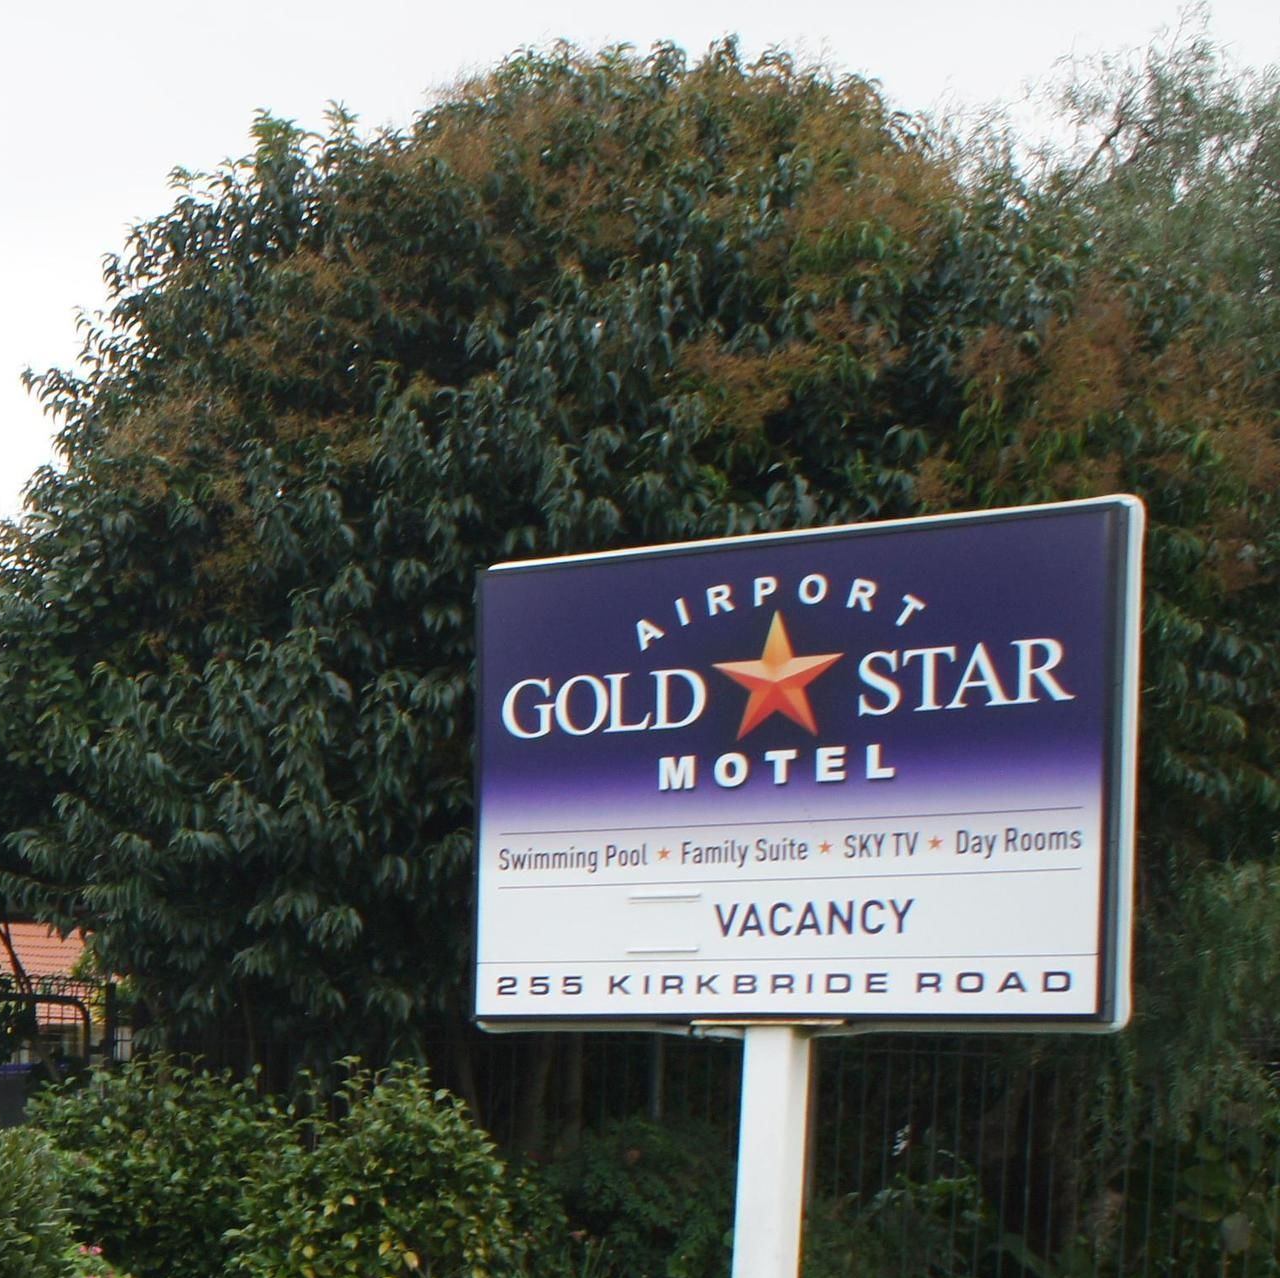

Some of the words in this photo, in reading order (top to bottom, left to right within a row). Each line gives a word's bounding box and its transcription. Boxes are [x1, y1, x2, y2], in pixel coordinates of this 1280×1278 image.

[636, 574, 925, 651] AIRPORT
[502, 668, 707, 739] GOLD
[857, 637, 1076, 718] STAR
[658, 744, 896, 790] MOTEL
[498, 845, 598, 874] Swimming
[605, 842, 648, 868] Pool
[680, 838, 748, 867] Family
[754, 838, 809, 863] Suite
[843, 834, 885, 859] SKY
[889, 831, 919, 856] TV
[955, 828, 997, 858] Day
[1004, 826, 1082, 852] Rooms
[715, 897, 915, 938] VACANCY
[496, 974, 584, 996] 255
[607, 971, 889, 996] KIRKBRIDE
[915, 970, 1074, 994] ROAD
